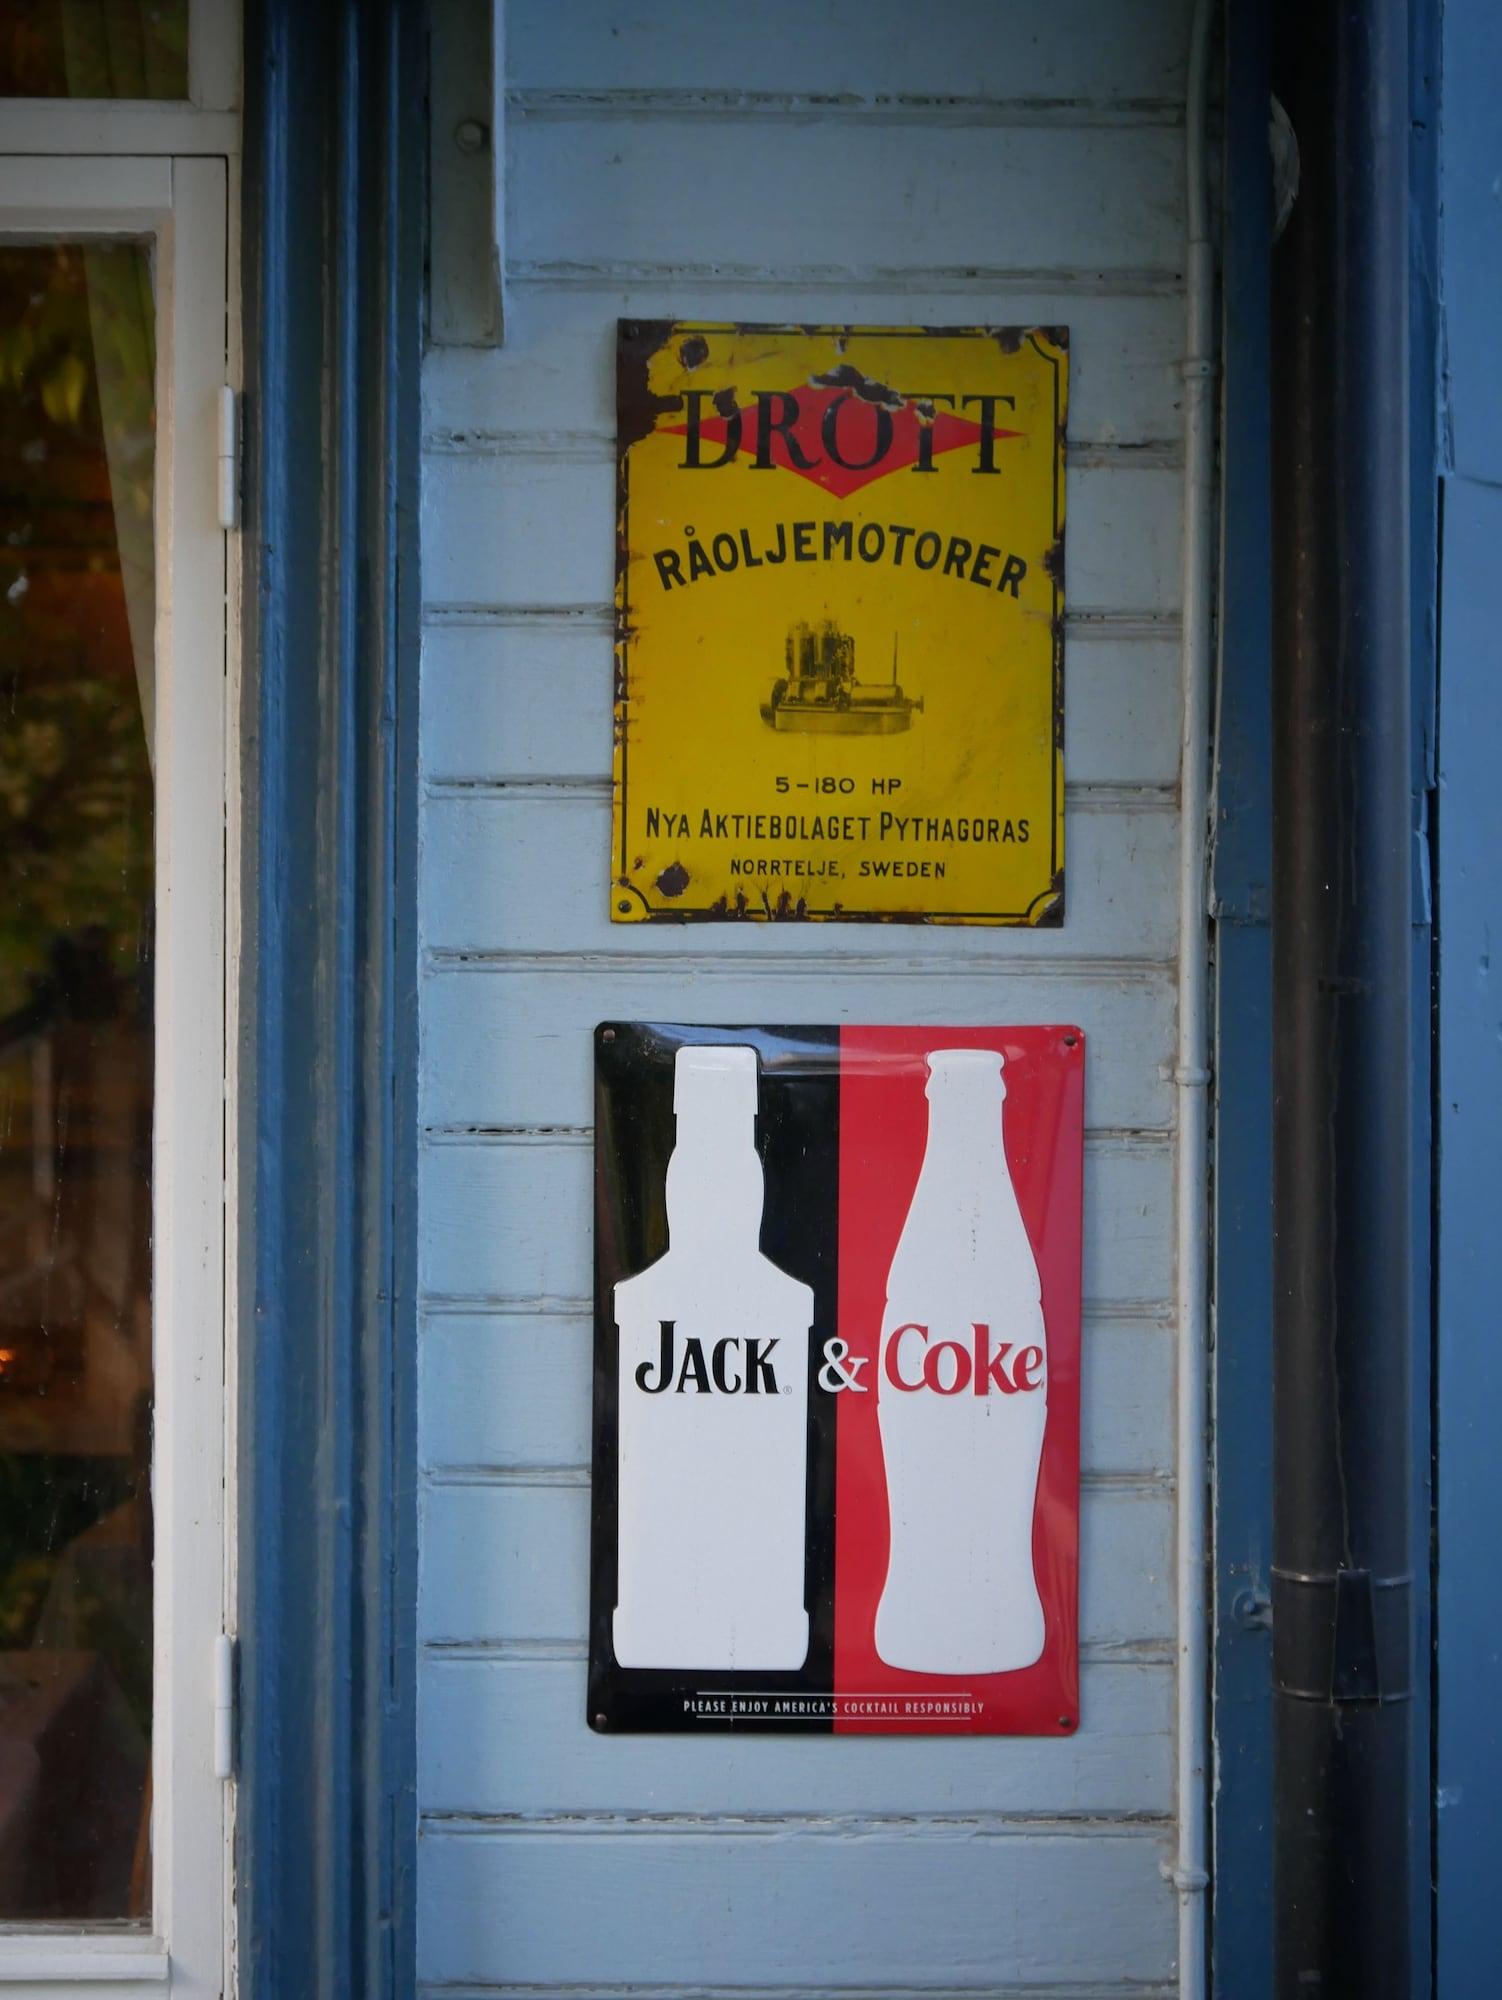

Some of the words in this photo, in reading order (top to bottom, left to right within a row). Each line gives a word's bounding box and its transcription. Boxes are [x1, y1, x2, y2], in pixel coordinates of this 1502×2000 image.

[678, 387, 1015, 474] DROTT
[653, 521, 1027, 599] RÅOLJEMOTORER
[871, 777, 902, 795] HP
[646, 807, 690, 839] NYA
[699, 809, 871, 841] AKTIEBOLAGET
[879, 811, 1030, 843] PYTHAGORAS
[730, 859, 846, 879] NORRTELJE,
[858, 861, 946, 878] SWEDEN
[817, 1336, 869, 1393] &
[884, 1323, 1043, 1396] Coke
[683, 1699, 727, 1713] PLEASE
[731, 1700, 769, 1713] ENJOY
[774, 1701, 839, 1714] AMERICA'S
[844, 1702, 900, 1714] COCKTAIL
[905, 1702, 985, 1715] RESPONSIBLY
